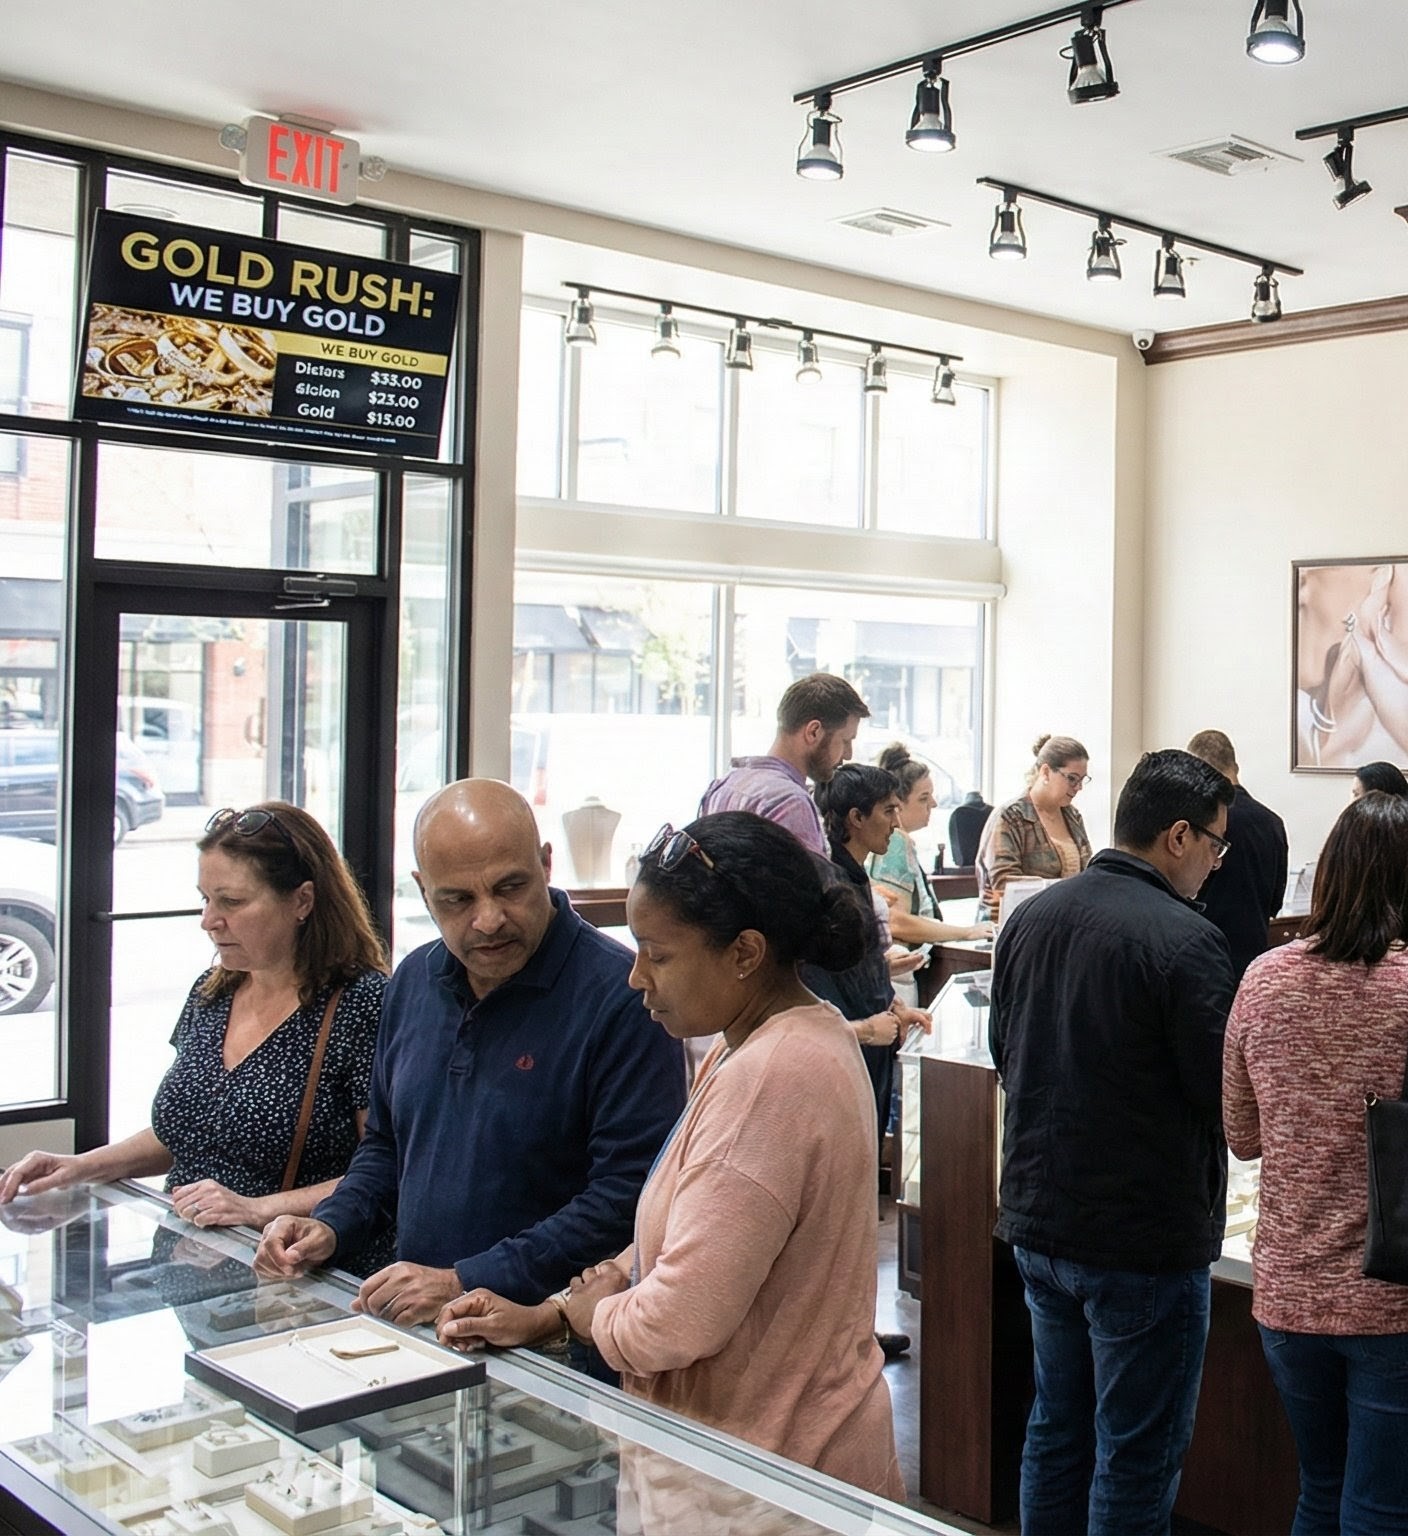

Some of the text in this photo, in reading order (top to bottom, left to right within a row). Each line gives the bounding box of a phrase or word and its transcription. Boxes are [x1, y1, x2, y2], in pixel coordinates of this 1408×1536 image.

[267, 123, 345, 194] EXIT
[121, 231, 435, 318] GOLD RUSH:
[170, 282, 386, 337] WE BUY GOLD
[320, 343, 419, 367] WE BUY GOLD
[370, 371, 422, 389] $33.00
[368, 390, 420, 409] $23.00
[297, 403, 336, 419] Gold
[366, 411, 416, 428] $15.00
